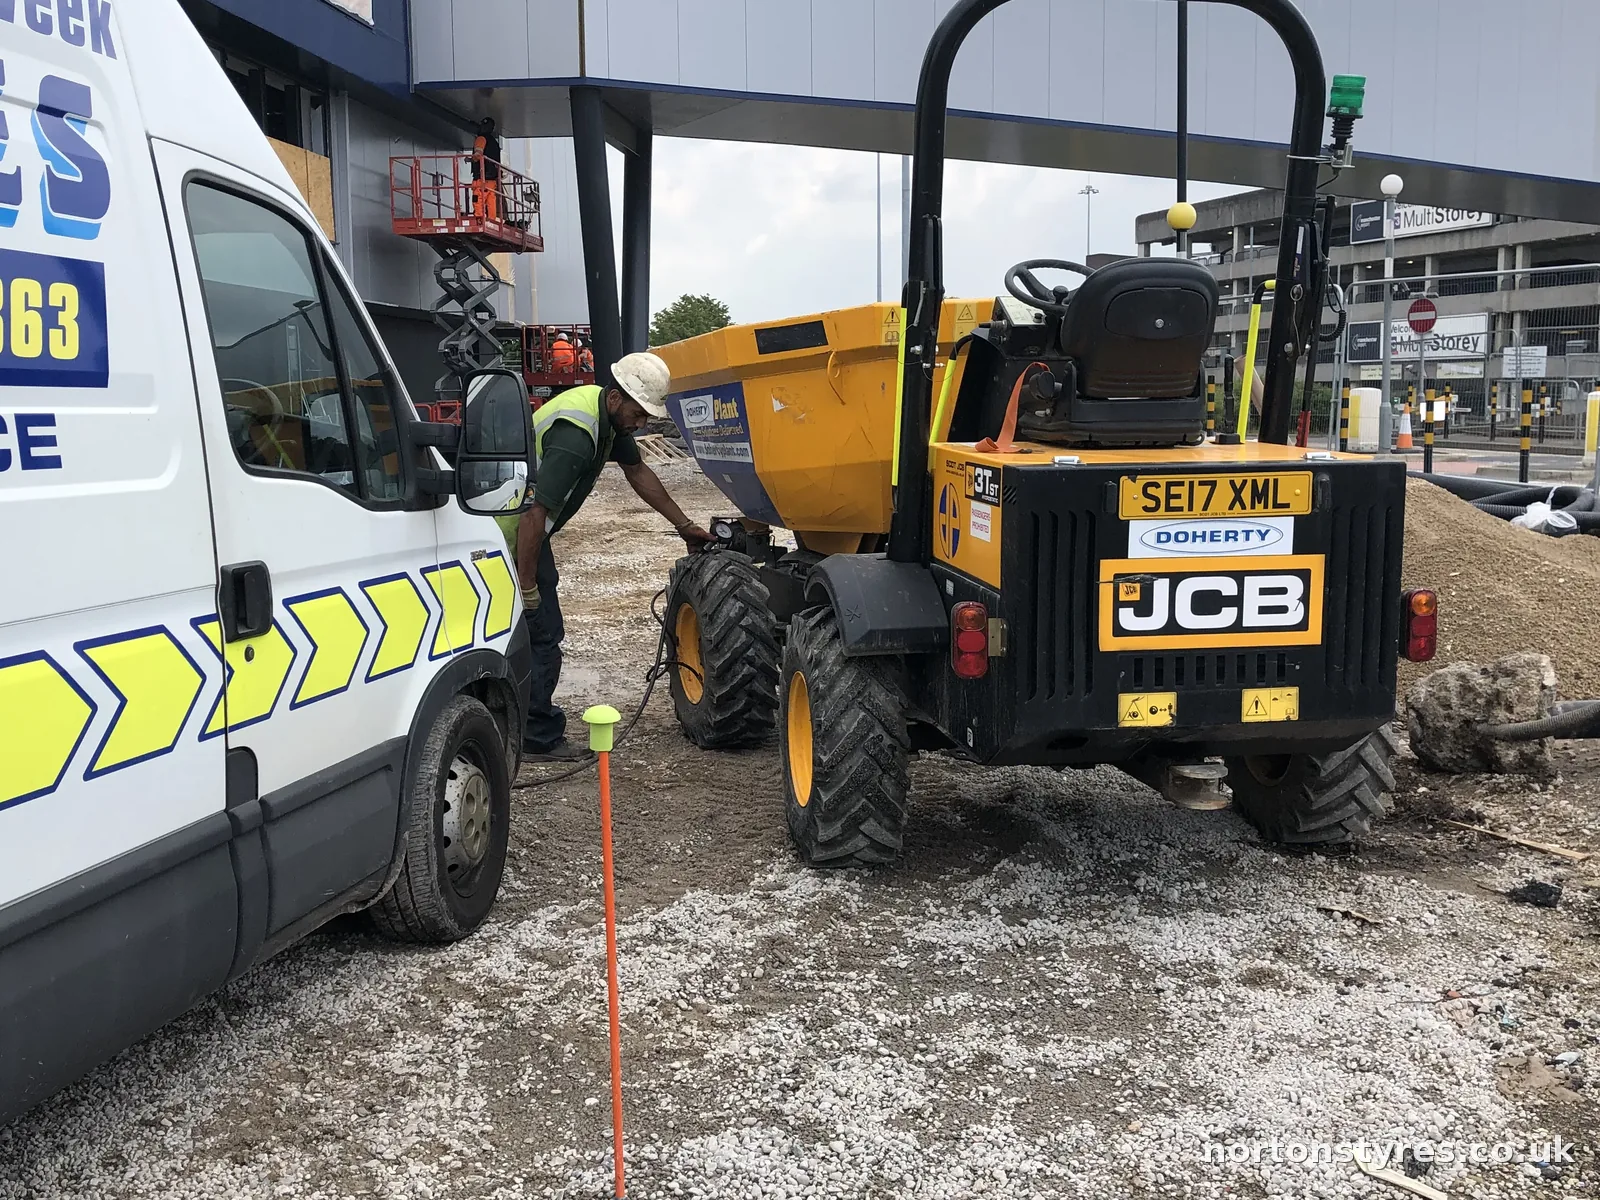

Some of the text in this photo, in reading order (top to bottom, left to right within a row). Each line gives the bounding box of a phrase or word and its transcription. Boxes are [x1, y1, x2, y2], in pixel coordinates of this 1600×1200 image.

[0, 0, 117, 60] eek
[0, 277, 79, 360] 63
[713, 397, 739, 420] Plant
[1141, 478, 1291, 513] SE17 XML
[1155, 529, 1271, 544] DOHERTY
[1118, 575, 1305, 631] JCB
